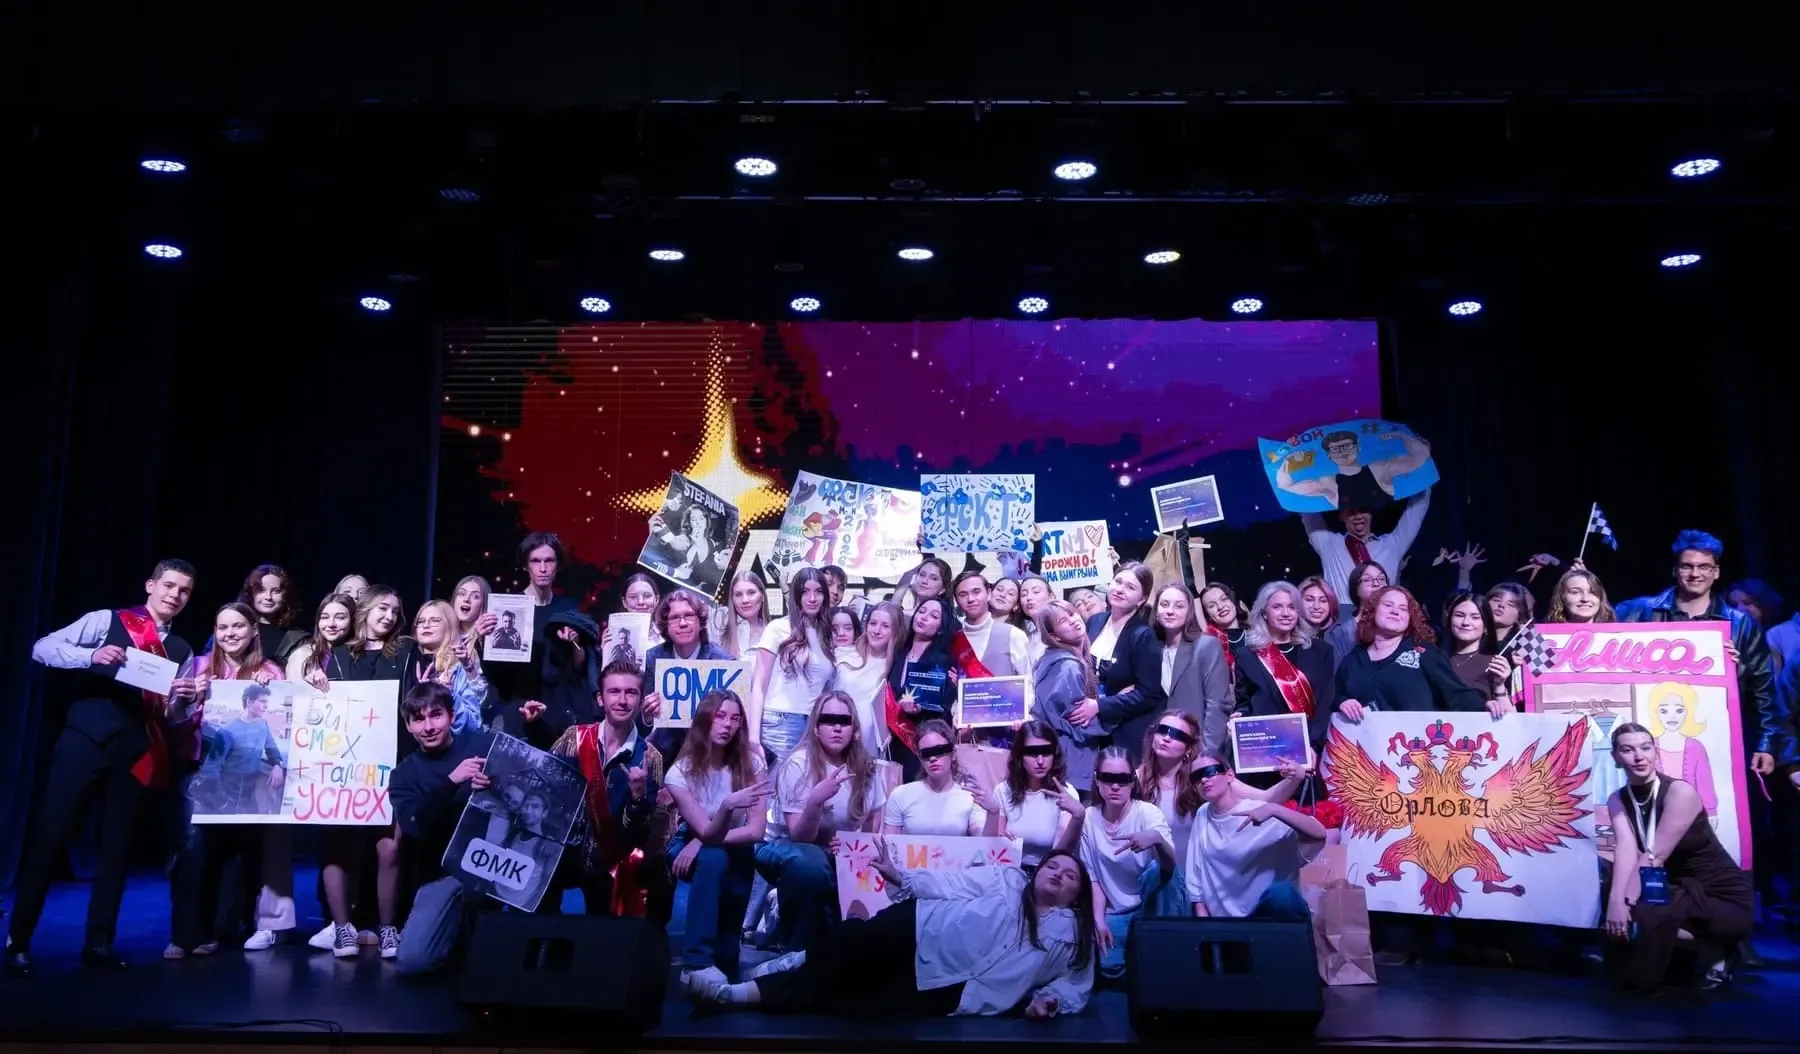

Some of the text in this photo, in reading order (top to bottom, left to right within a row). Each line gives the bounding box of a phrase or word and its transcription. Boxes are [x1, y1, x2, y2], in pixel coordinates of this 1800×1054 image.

[683, 483, 726, 516] STEFANIA
[936, 490, 1020, 534] ФСКТ
[470, 848, 528, 884] ФМК
